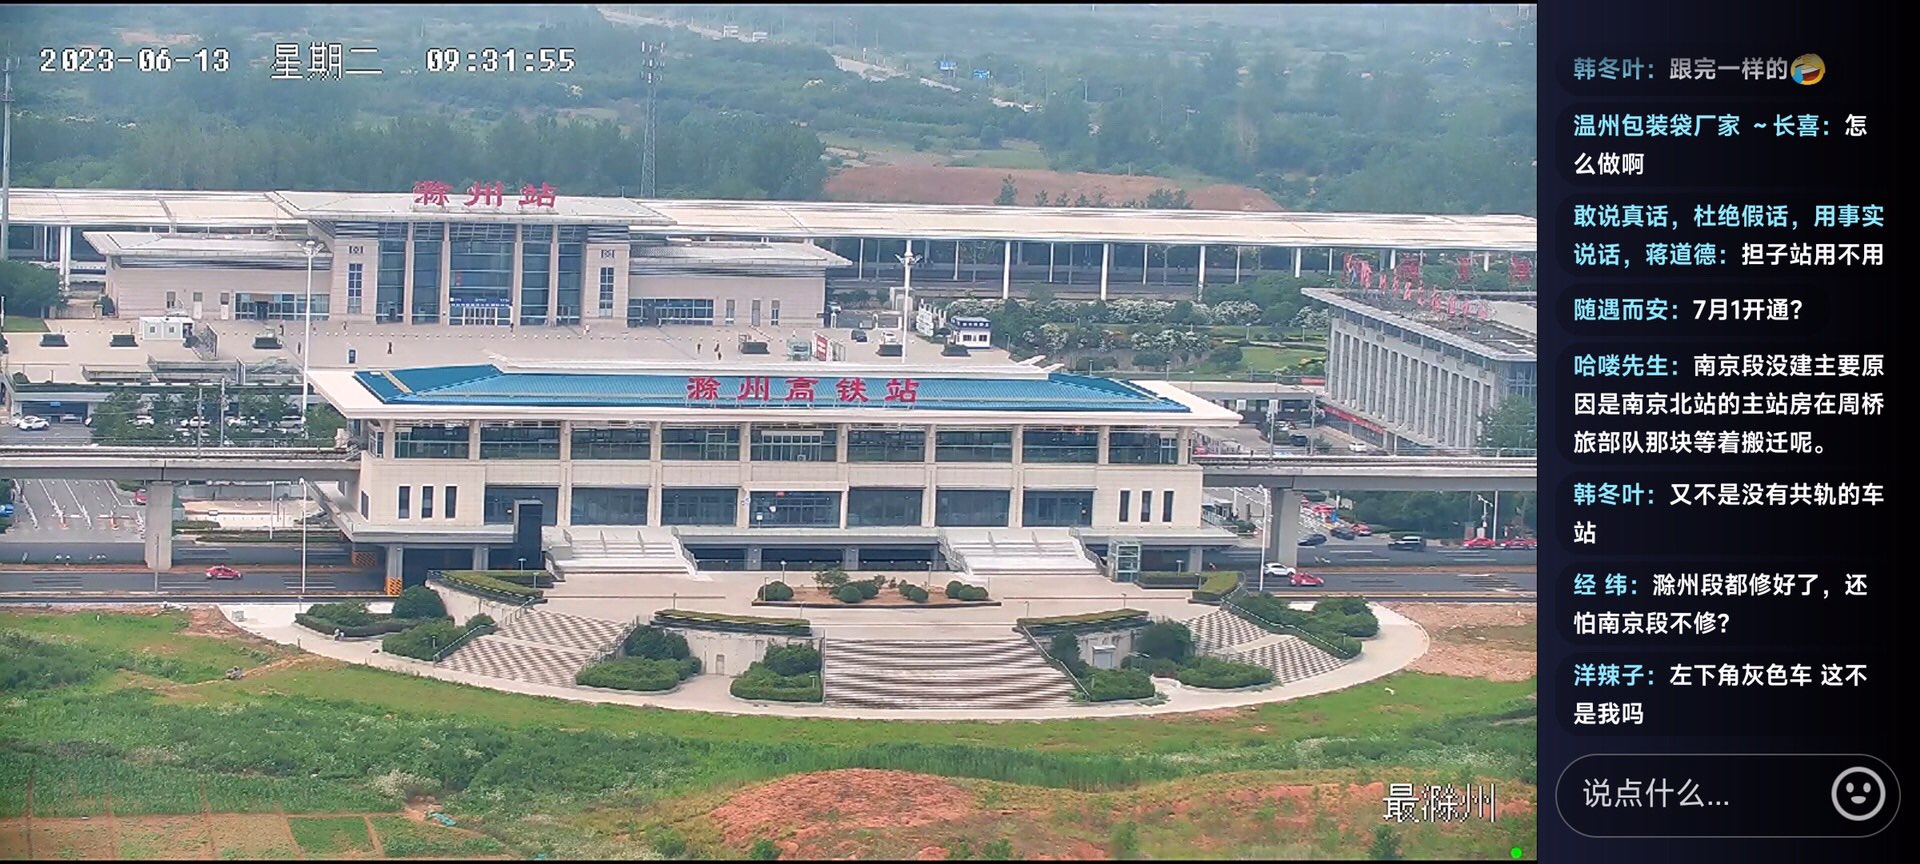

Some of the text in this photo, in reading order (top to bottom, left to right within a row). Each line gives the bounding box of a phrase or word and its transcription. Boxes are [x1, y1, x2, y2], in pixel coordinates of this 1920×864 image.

[413, 180, 558, 207] 滁州站
[686, 375, 920, 402] 滁州高铁站
